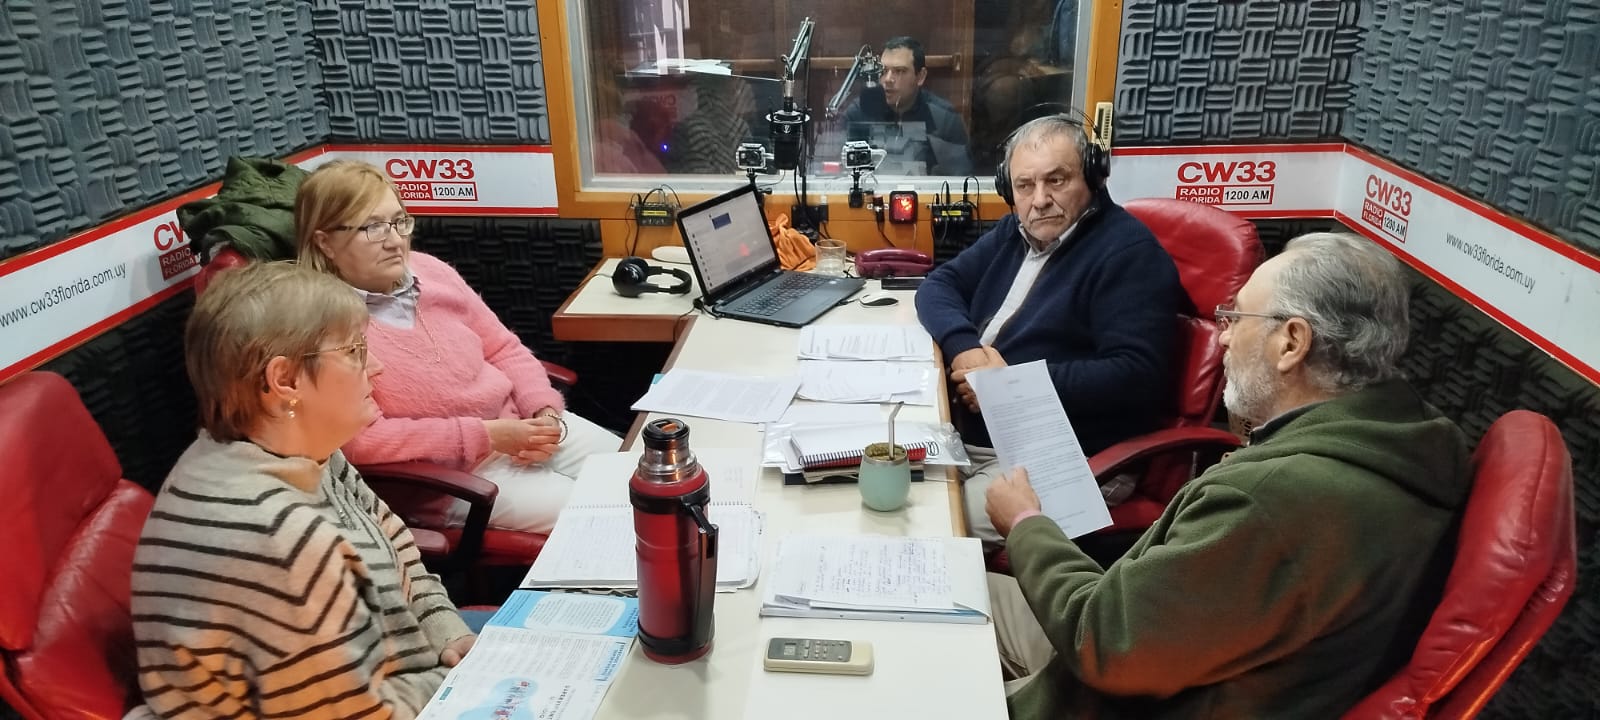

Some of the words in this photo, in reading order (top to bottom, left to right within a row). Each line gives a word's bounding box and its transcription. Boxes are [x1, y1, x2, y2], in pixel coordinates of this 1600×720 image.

[385, 159, 475, 179] CW33
[1177, 161, 1276, 183] CW33
[433, 187, 455, 196] 1200
[458, 188, 473, 197] AM
[1225, 191, 1249, 200] 1200
[1252, 190, 1269, 199] AM
[1366, 175, 1412, 216] CW33
[1365, 201, 1383, 217] RADIO
[1396, 223, 1406, 237] AM
[162, 248, 191, 266] RADIO
[1446, 232, 1536, 294] www.cw33florida.com.uy
[165, 258, 195, 277] FLORIDA
[0, 263, 126, 328] www.cw33florida.com.uy
